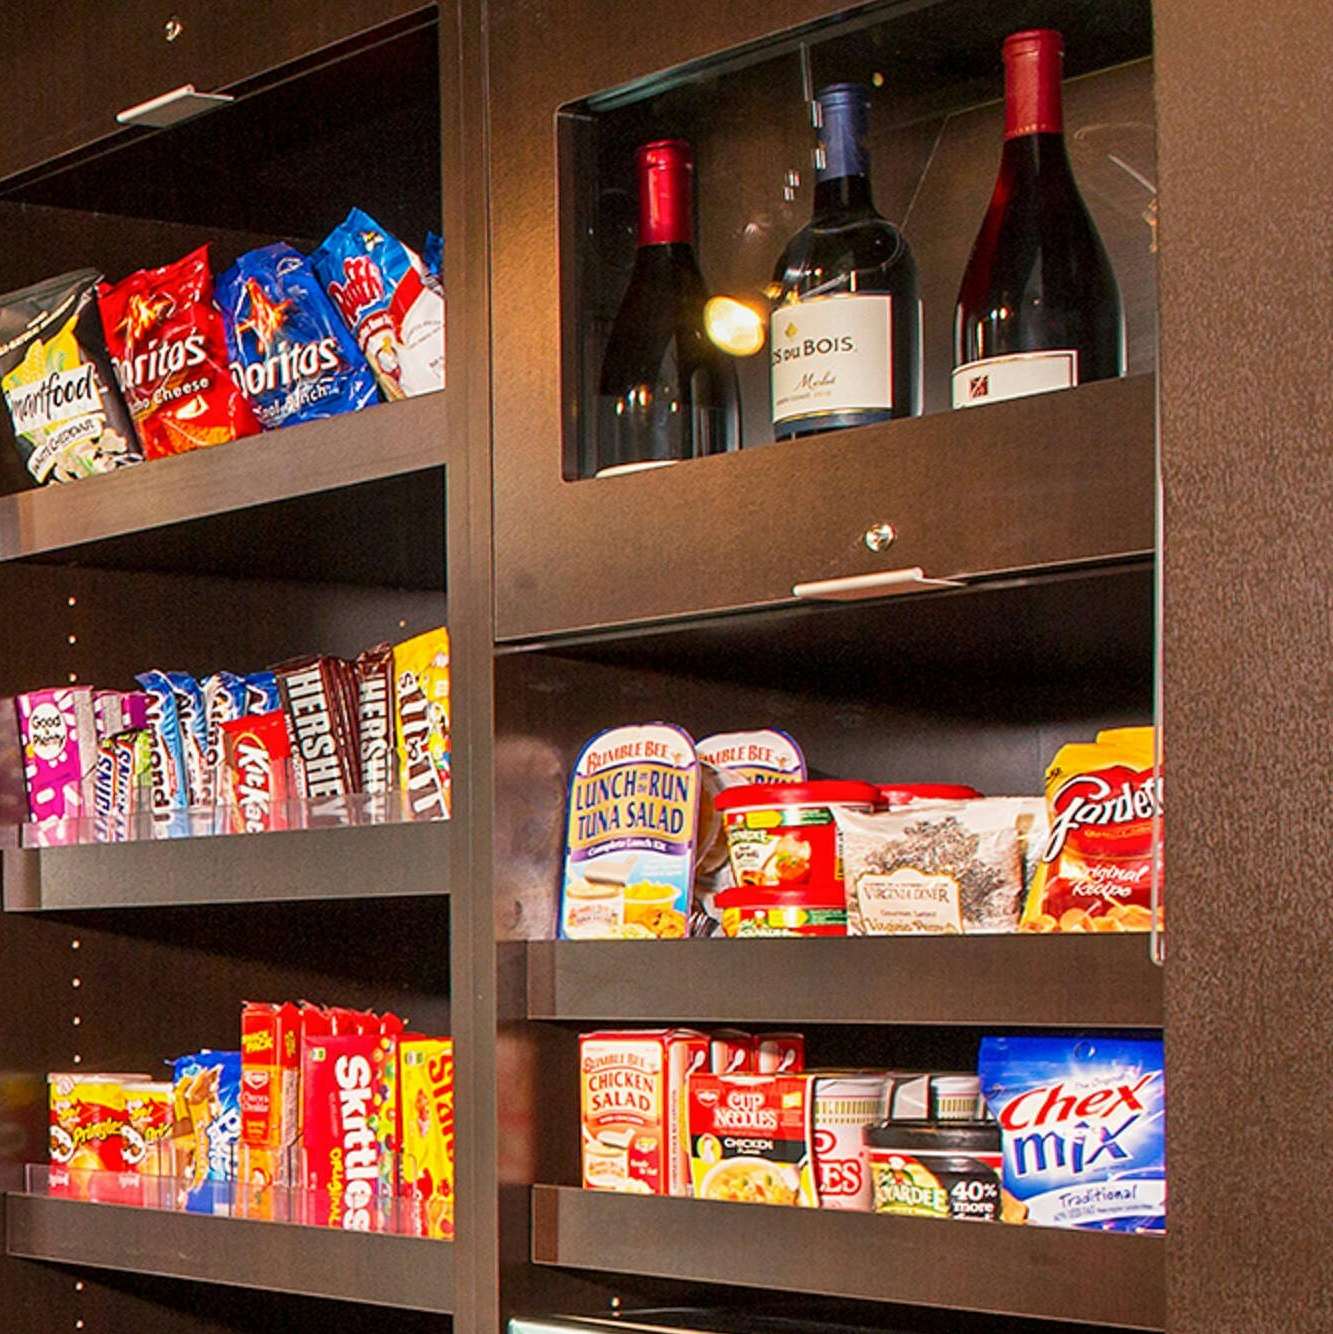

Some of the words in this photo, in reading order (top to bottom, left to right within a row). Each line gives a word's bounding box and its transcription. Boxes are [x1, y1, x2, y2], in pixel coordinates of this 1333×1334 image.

[803, 336, 854, 356] BOIS
[153, 375, 210, 406] Cheese
[31, 714, 62, 729] Good
[32, 734, 66, 748] Plenty
[145, 690, 172, 808] Almond
[586, 741, 644, 776] BUMBLE
[644, 739, 669, 759] BEE
[746, 744, 773, 763] BEE
[576, 770, 637, 811] LUNCH
[649, 768, 690, 803] RUN
[578, 805, 621, 841] TUNA
[626, 800, 684, 835] SALAD
[1077, 863, 1151, 888] riginal
[588, 1071, 654, 1093] CHICKEN
[592, 1090, 651, 1112] SALAD
[726, 1091, 765, 1111] CUP
[999, 1073, 1155, 1132] Chex
[713, 1107, 778, 1131] NOODLES
[334, 1054, 380, 1230] Skittles
[723, 1138, 774, 1150] CHICKEN
[1012, 1113, 1141, 1177] mix
[876, 1184, 949, 1213] YARDEE
[950, 1181, 997, 1201] 40%
[1058, 1184, 1138, 1208] Traditional
[951, 1201, 995, 1215] more
